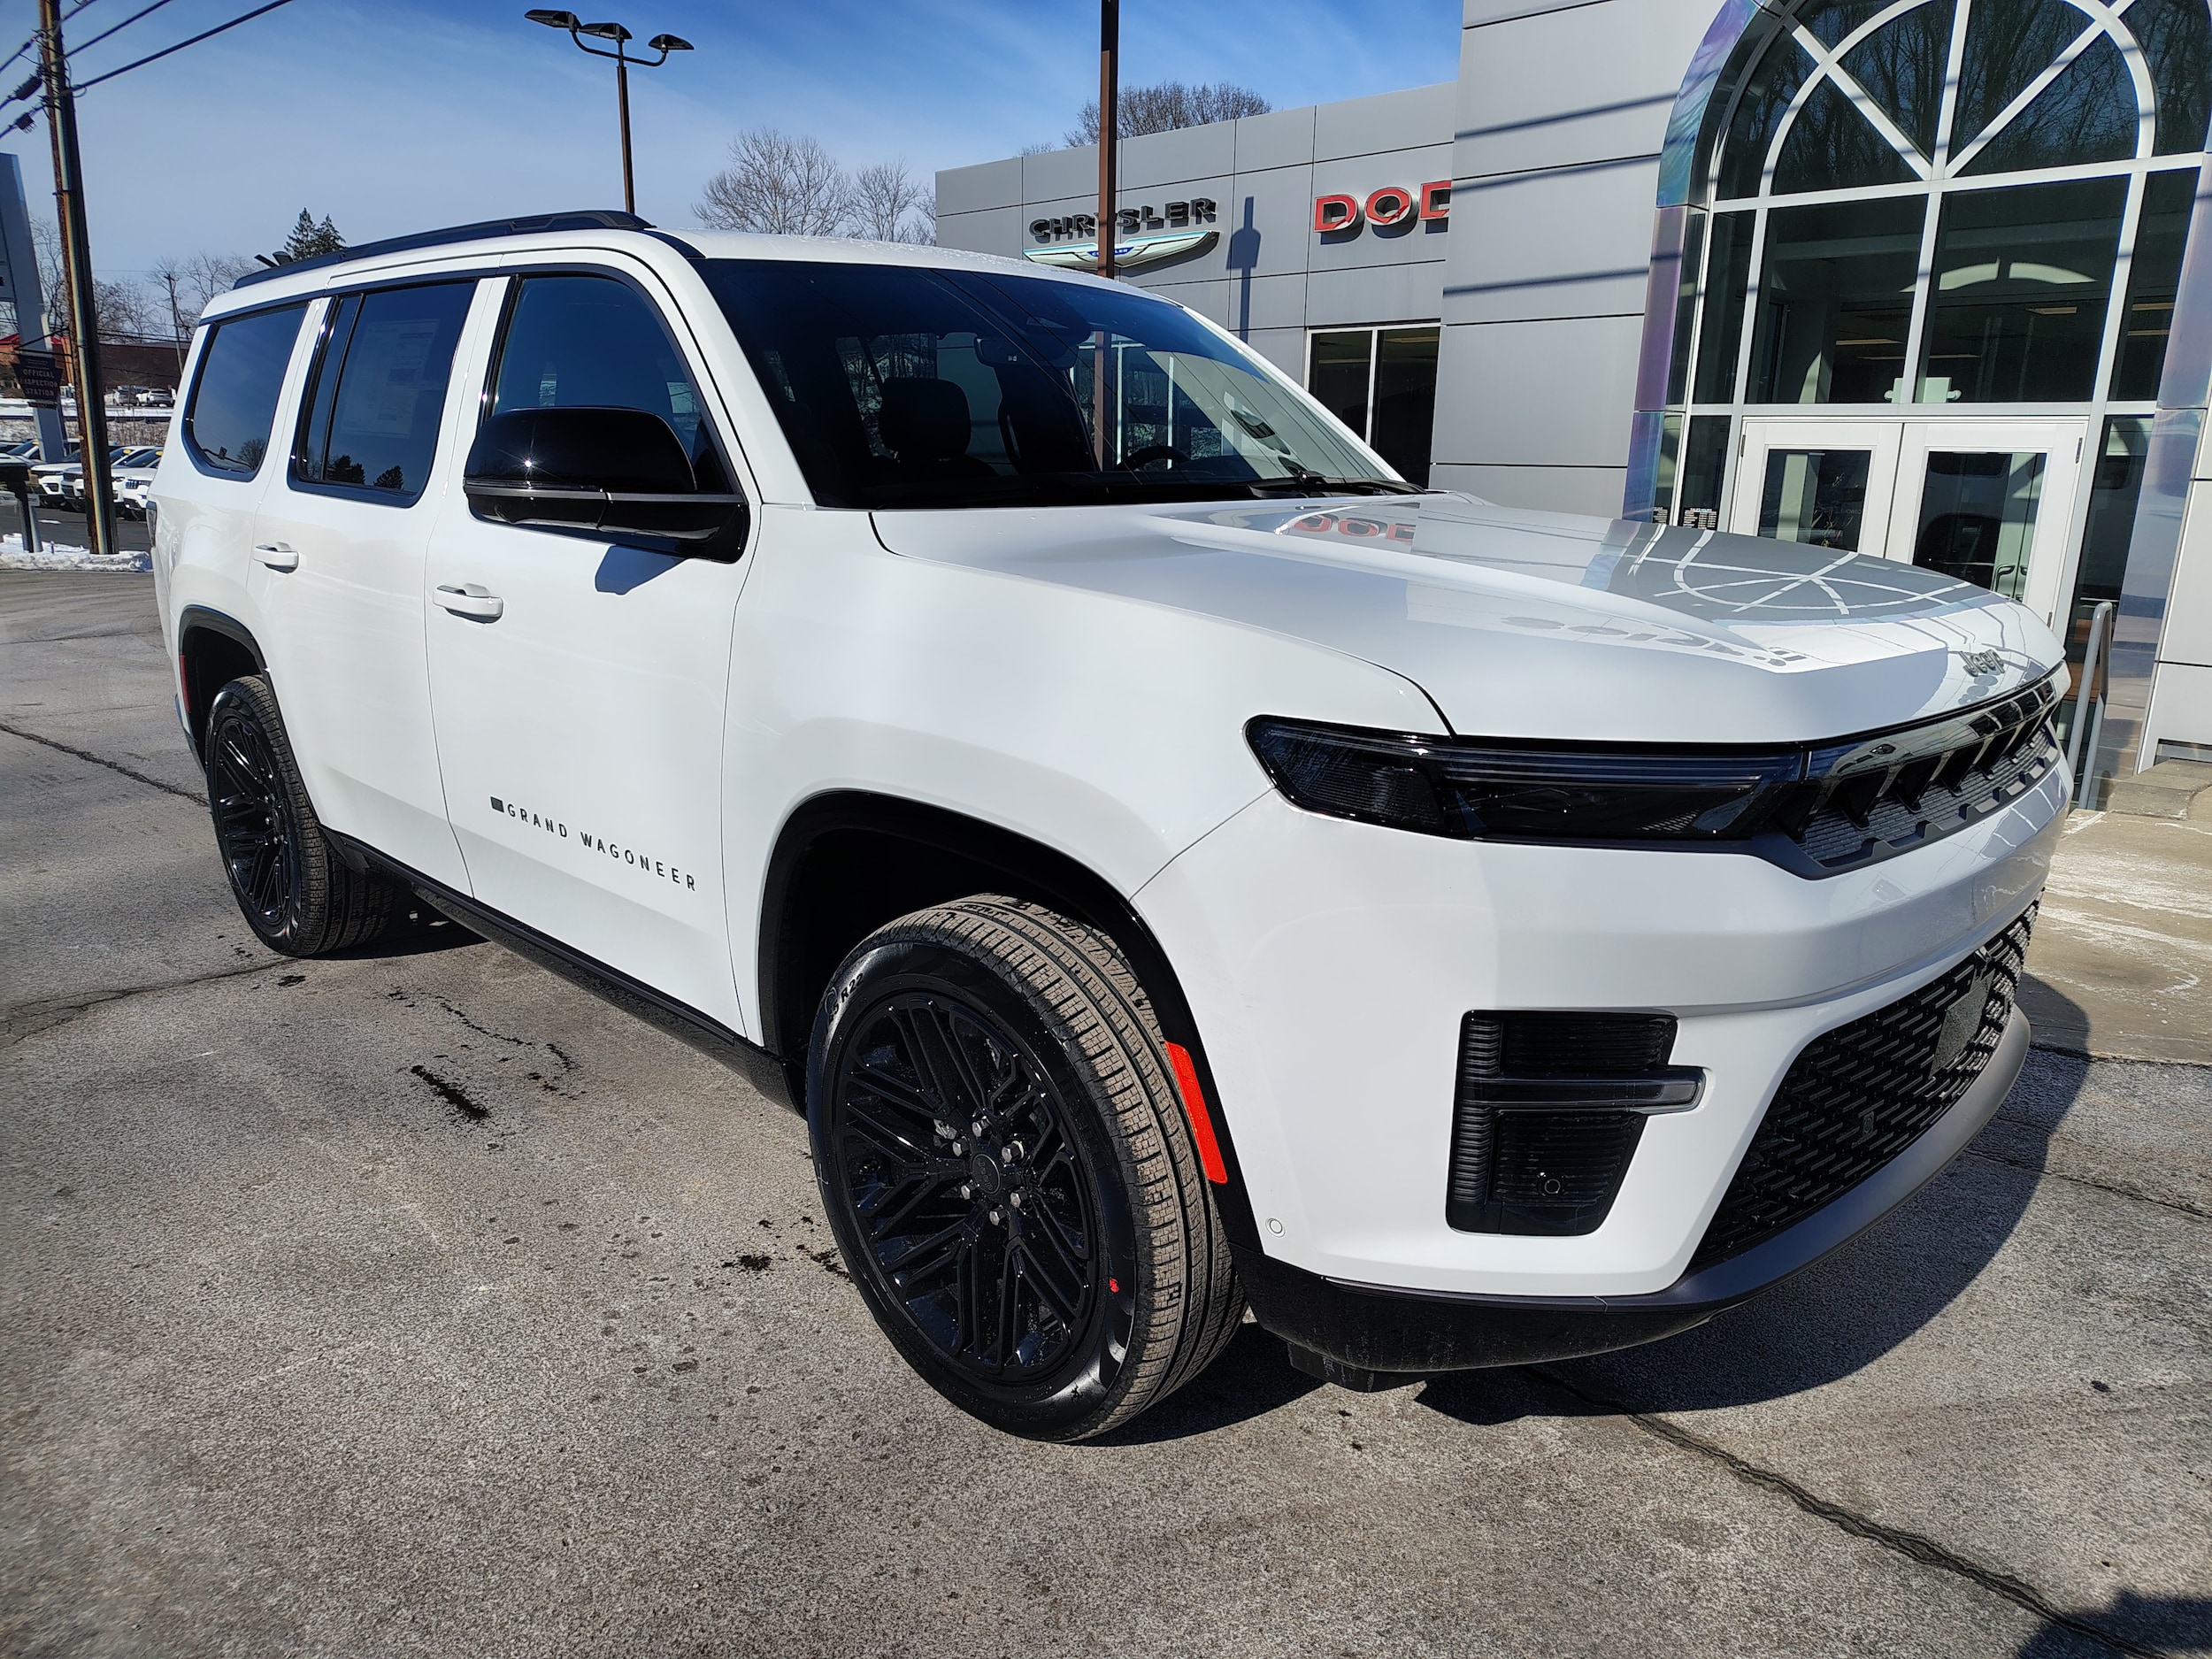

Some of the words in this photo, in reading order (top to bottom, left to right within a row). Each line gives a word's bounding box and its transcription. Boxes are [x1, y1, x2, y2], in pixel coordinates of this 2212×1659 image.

[1028, 197, 1217, 238] CHRSLER
[22, 368, 55, 379] OFFICIAL
[25, 388, 55, 396] STATION
[1958, 649, 2005, 677] Jeep
[507, 803, 568, 838] GRAND
[580, 831, 696, 892] WAGONEER
